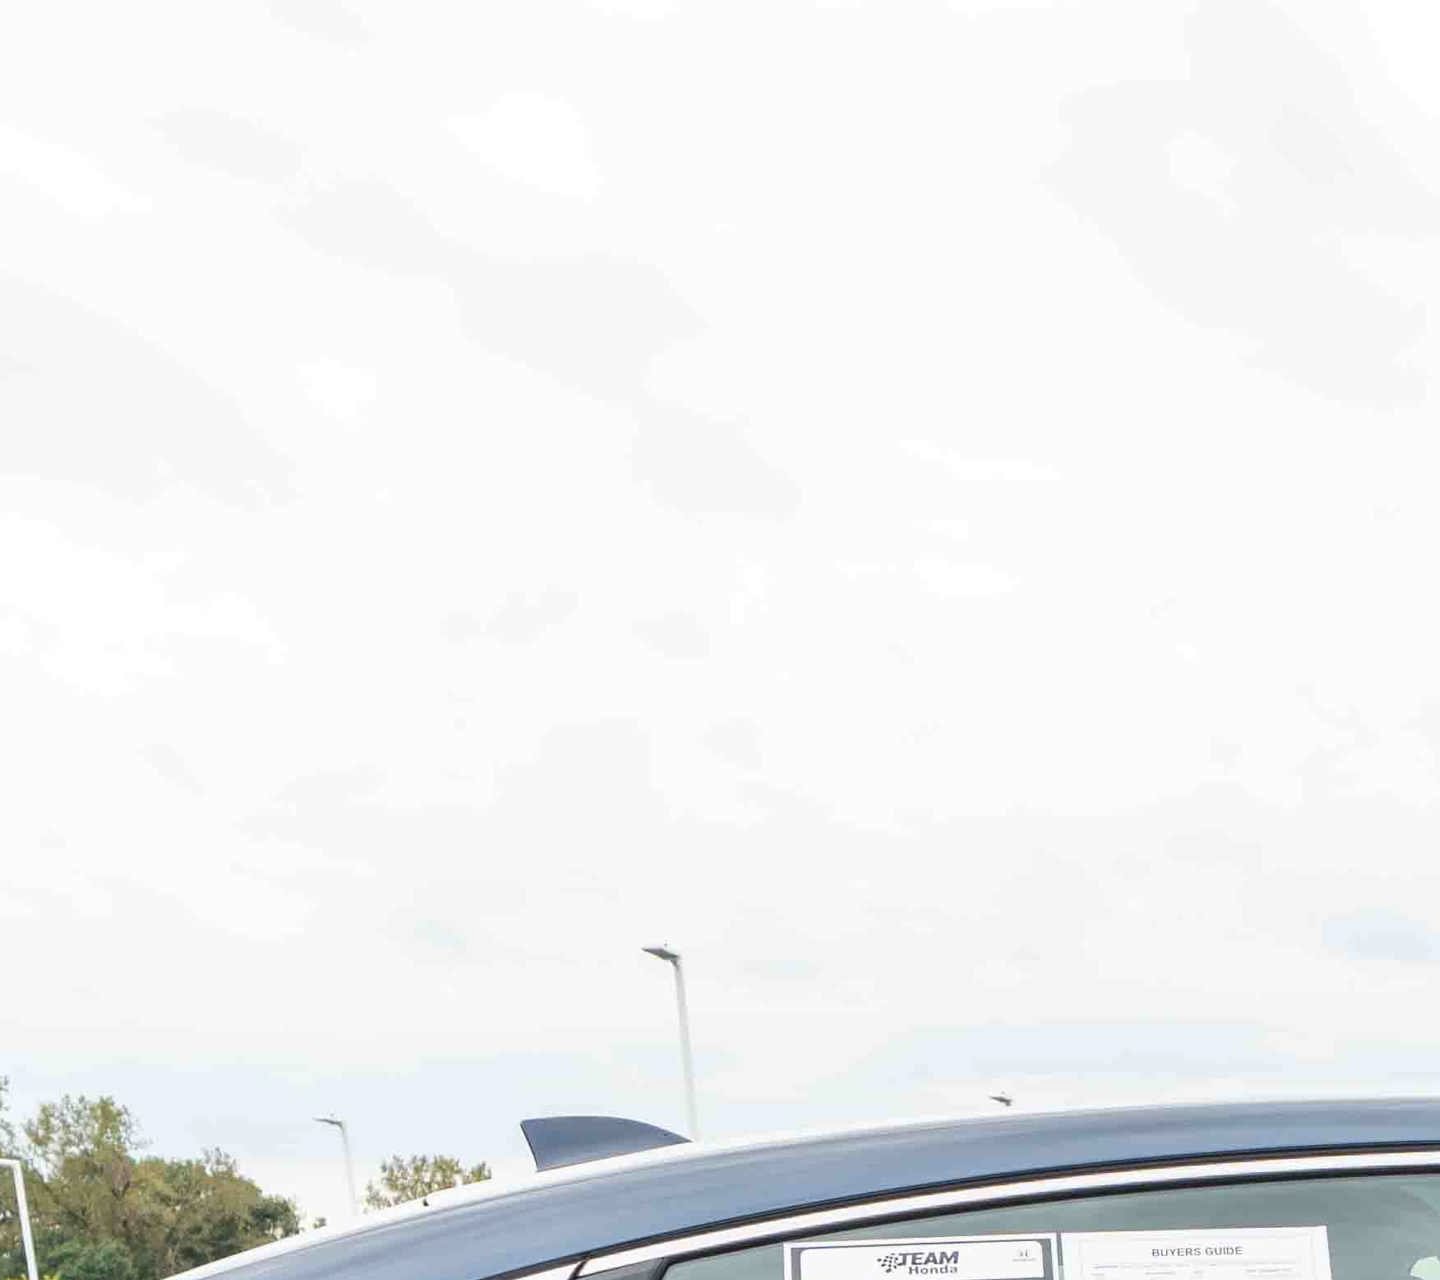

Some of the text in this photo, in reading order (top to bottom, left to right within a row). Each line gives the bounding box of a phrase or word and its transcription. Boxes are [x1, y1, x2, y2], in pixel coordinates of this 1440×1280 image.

[897, 1250, 959, 1266] TEAM
[1151, 1246, 1244, 1258] BUYERS GUIDE
[908, 1265, 959, 1275] Honda
